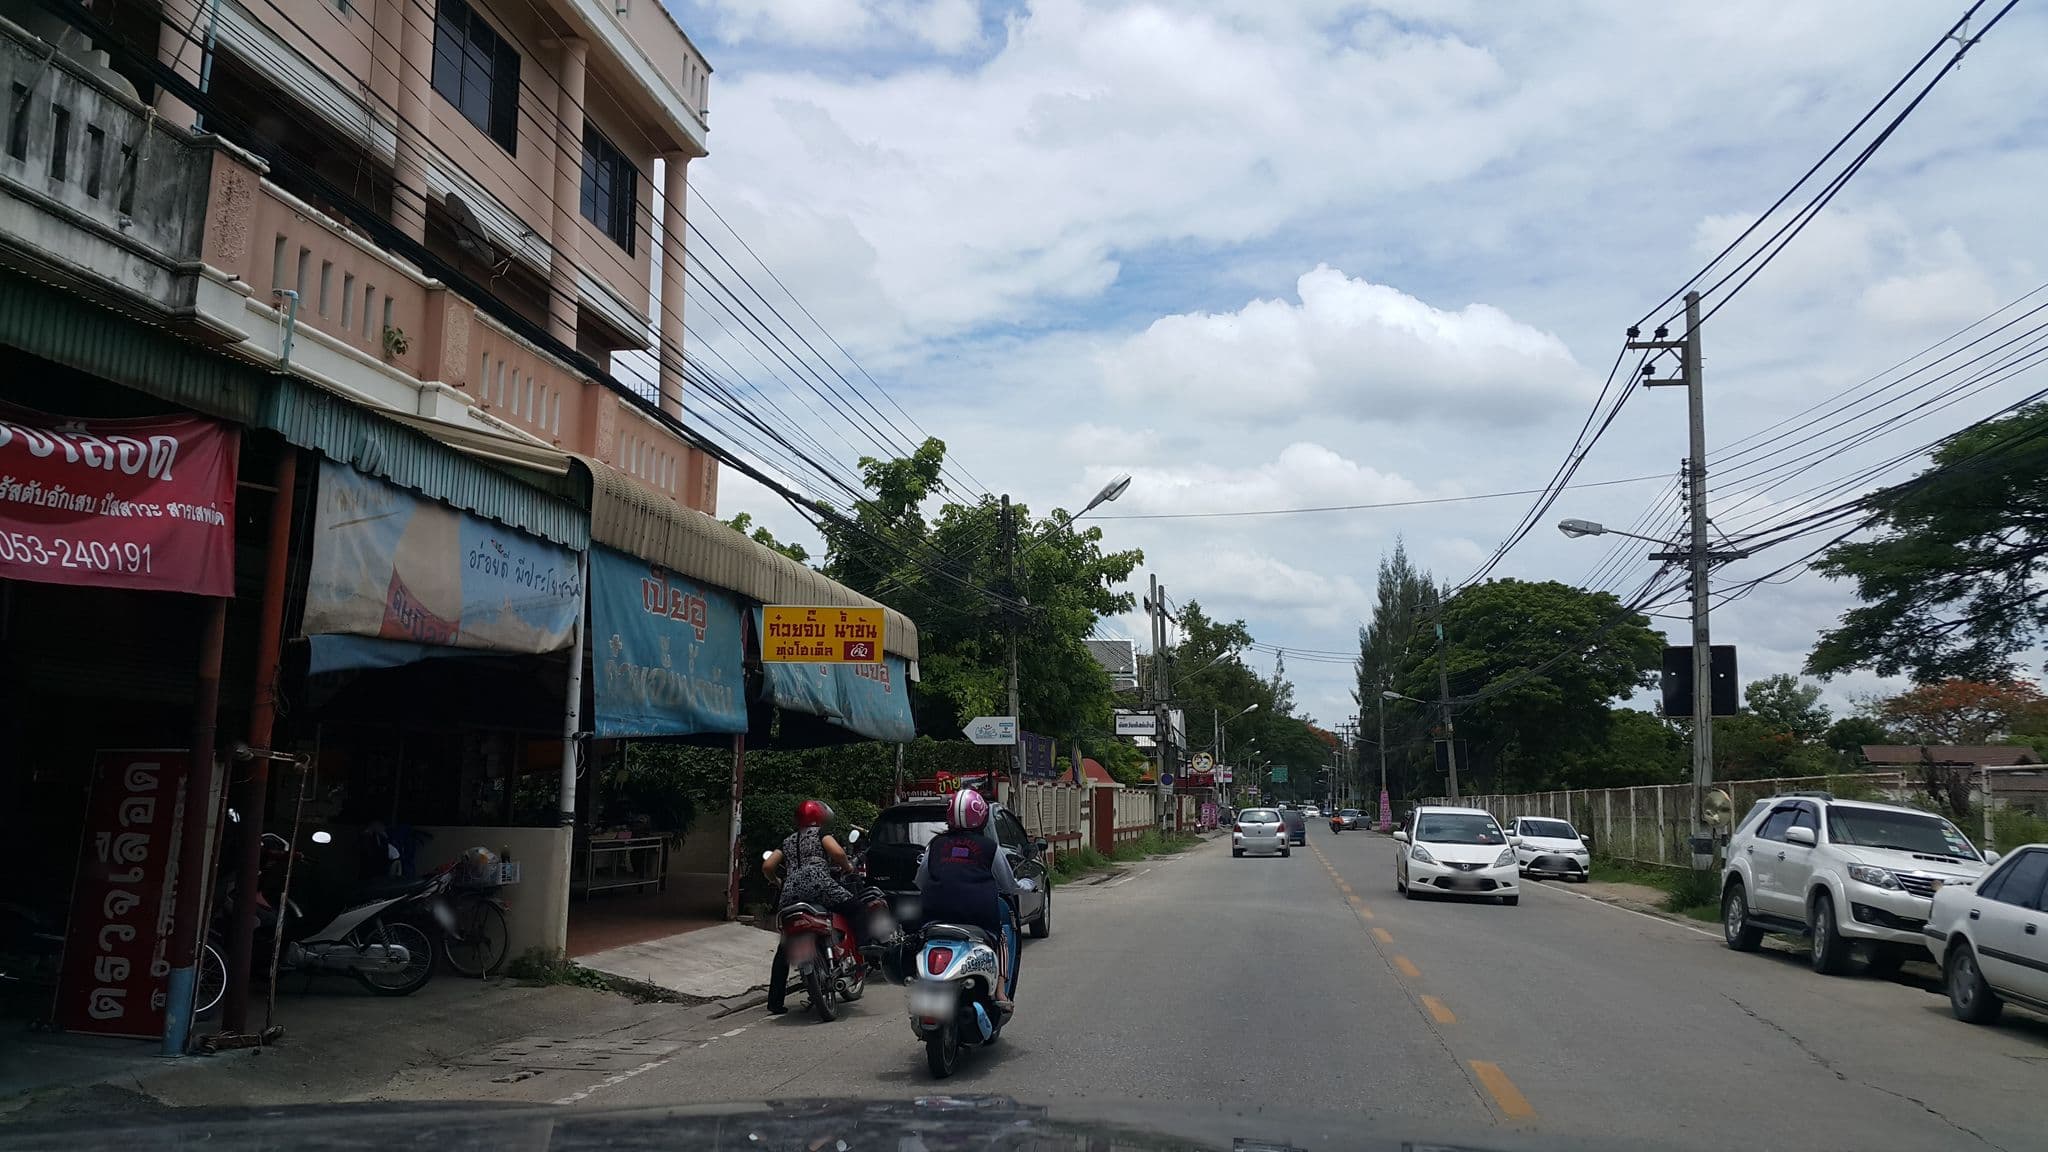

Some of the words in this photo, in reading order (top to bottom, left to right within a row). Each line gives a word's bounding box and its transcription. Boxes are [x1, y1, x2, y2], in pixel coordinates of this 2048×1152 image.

[0, 529, 152, 574] 053-240191
[469, 539, 510, 579] อร่อยดี
[769, 609, 826, 638] ก๋วยจั๊บ
[88, 762, 161, 1021] ตรวจเลือด
